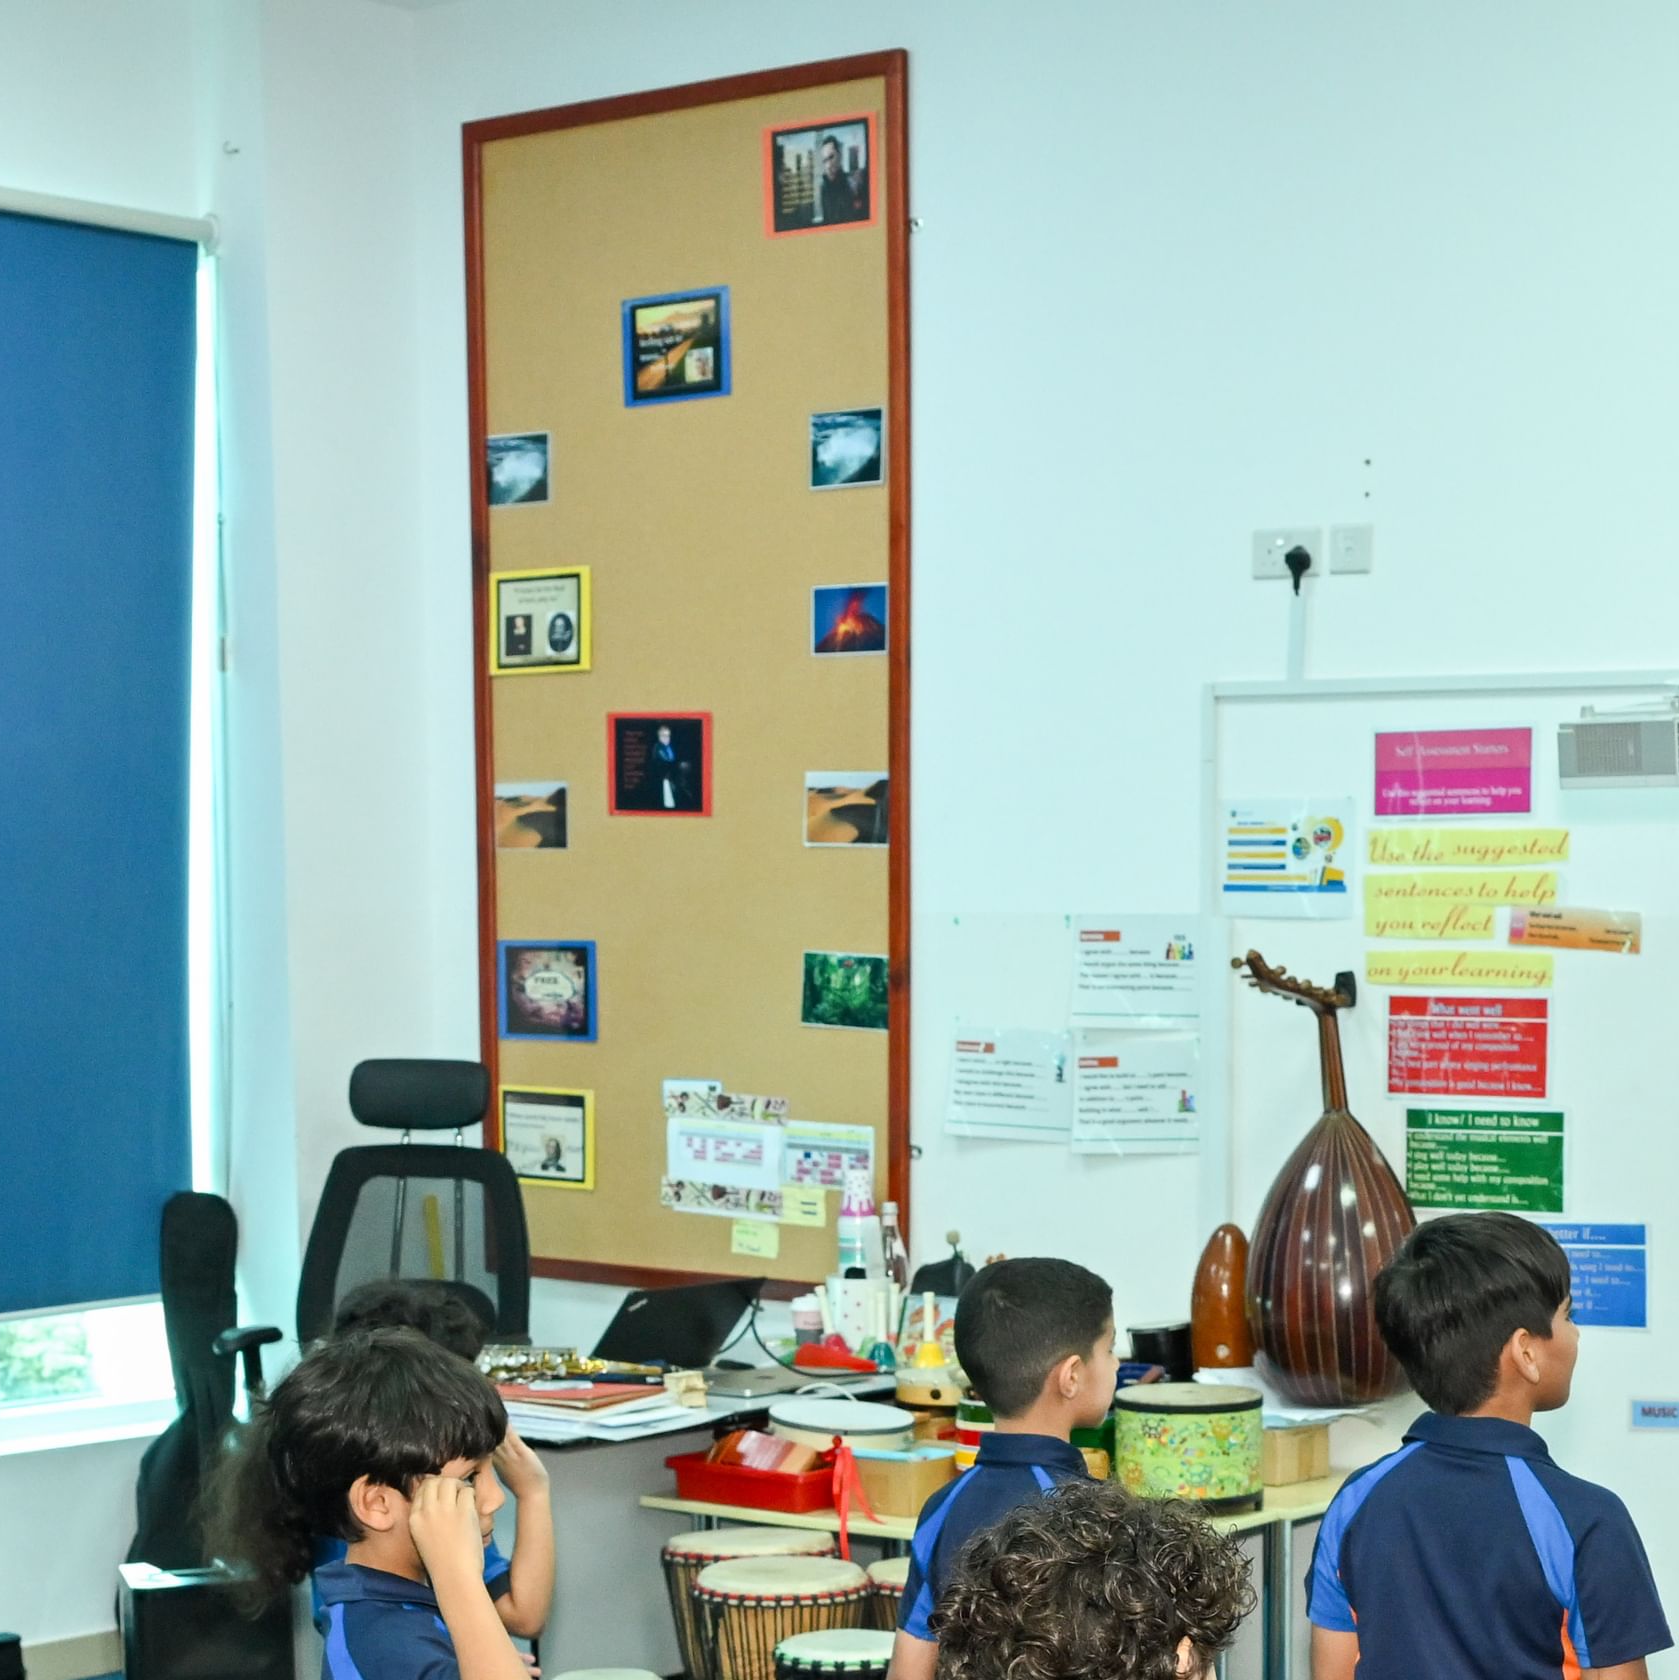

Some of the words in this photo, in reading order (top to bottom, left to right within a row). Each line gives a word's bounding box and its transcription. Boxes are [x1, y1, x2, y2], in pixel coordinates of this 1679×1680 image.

[1368, 836, 1405, 863] Use
[1412, 839, 1444, 862] the
[1452, 831, 1569, 862] suggested
[1374, 881, 1473, 899] sentences
[1477, 881, 1499, 899] to
[1504, 872, 1556, 905] help
[1375, 918, 1416, 937] you
[1421, 904, 1492, 938] reflect
[1368, 965, 1391, 978] on
[1397, 963, 1448, 982] your
[1483, 1003, 1503, 1017] well
[1474, 1114, 1498, 1127] need
[1513, 1114, 1540, 1128] know
[1641, 1406, 1678, 1418] MUSIC
